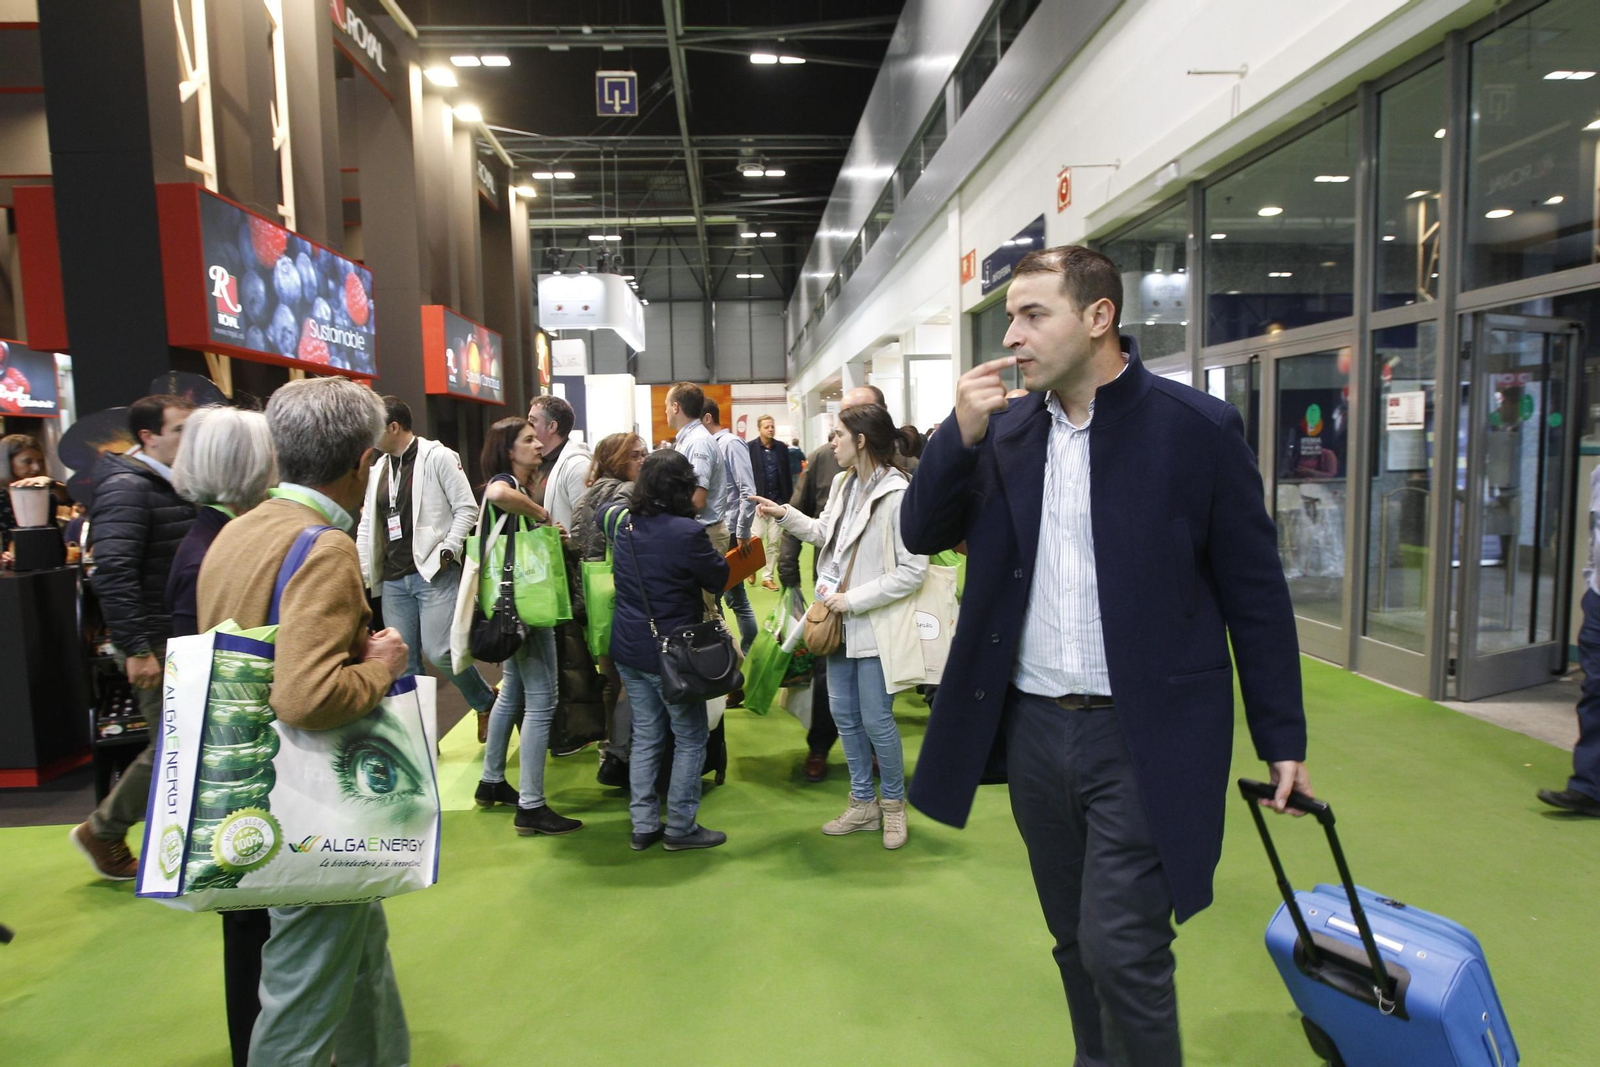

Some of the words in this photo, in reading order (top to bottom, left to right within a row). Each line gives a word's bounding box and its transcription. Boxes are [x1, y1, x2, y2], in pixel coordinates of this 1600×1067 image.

[346, 6, 387, 73] ROYAL
[309, 318, 367, 351] Sustainable
[224, 818, 267, 842] MICROALGHE
[234, 832, 263, 851] 100%
[320, 837, 425, 852] ALGAENERGY
[230, 844, 271, 865] NATURALE
